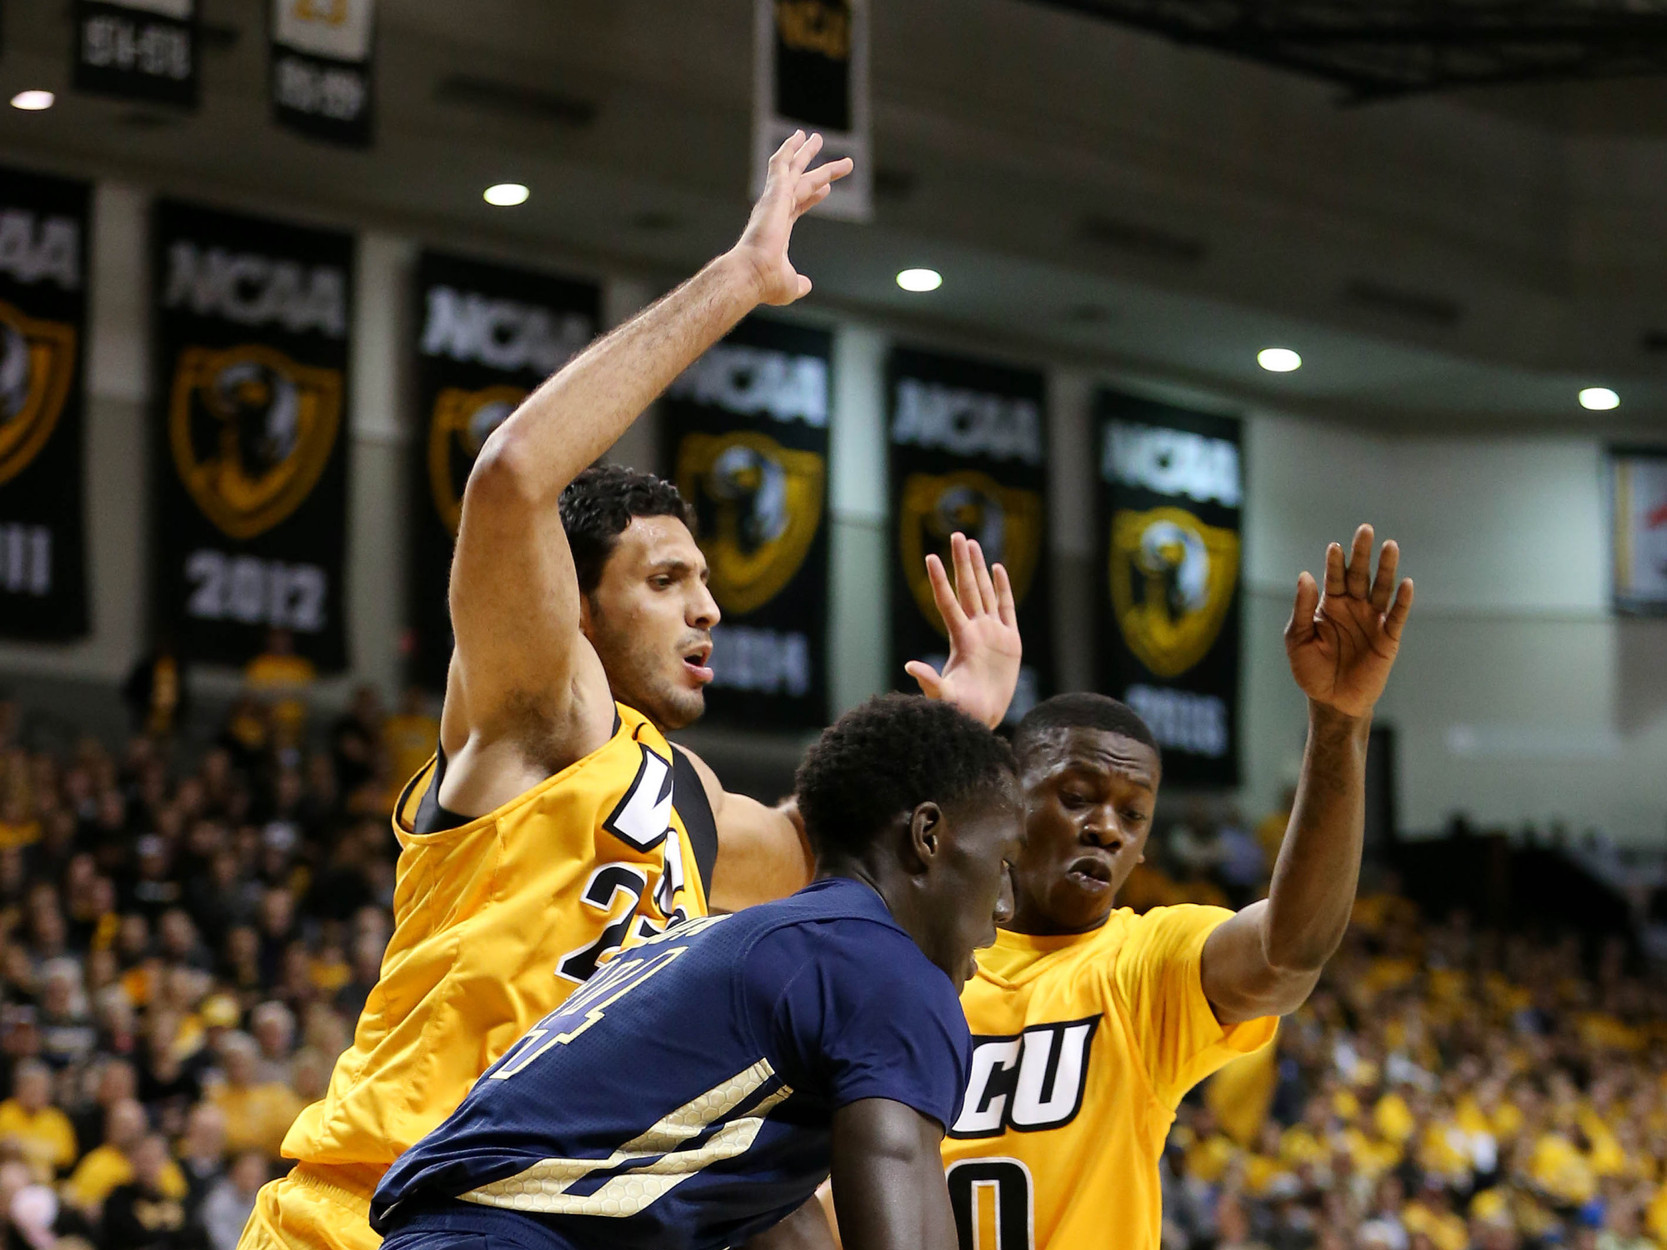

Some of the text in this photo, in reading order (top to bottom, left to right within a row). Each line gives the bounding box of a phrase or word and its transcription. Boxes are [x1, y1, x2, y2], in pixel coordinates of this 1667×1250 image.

[166, 240, 346, 336] NCAA
[893, 377, 1043, 465] NCAA
[1104, 418, 1242, 508] NCAA
[187, 548, 326, 634] 2012
[488, 944, 690, 1080] 4
